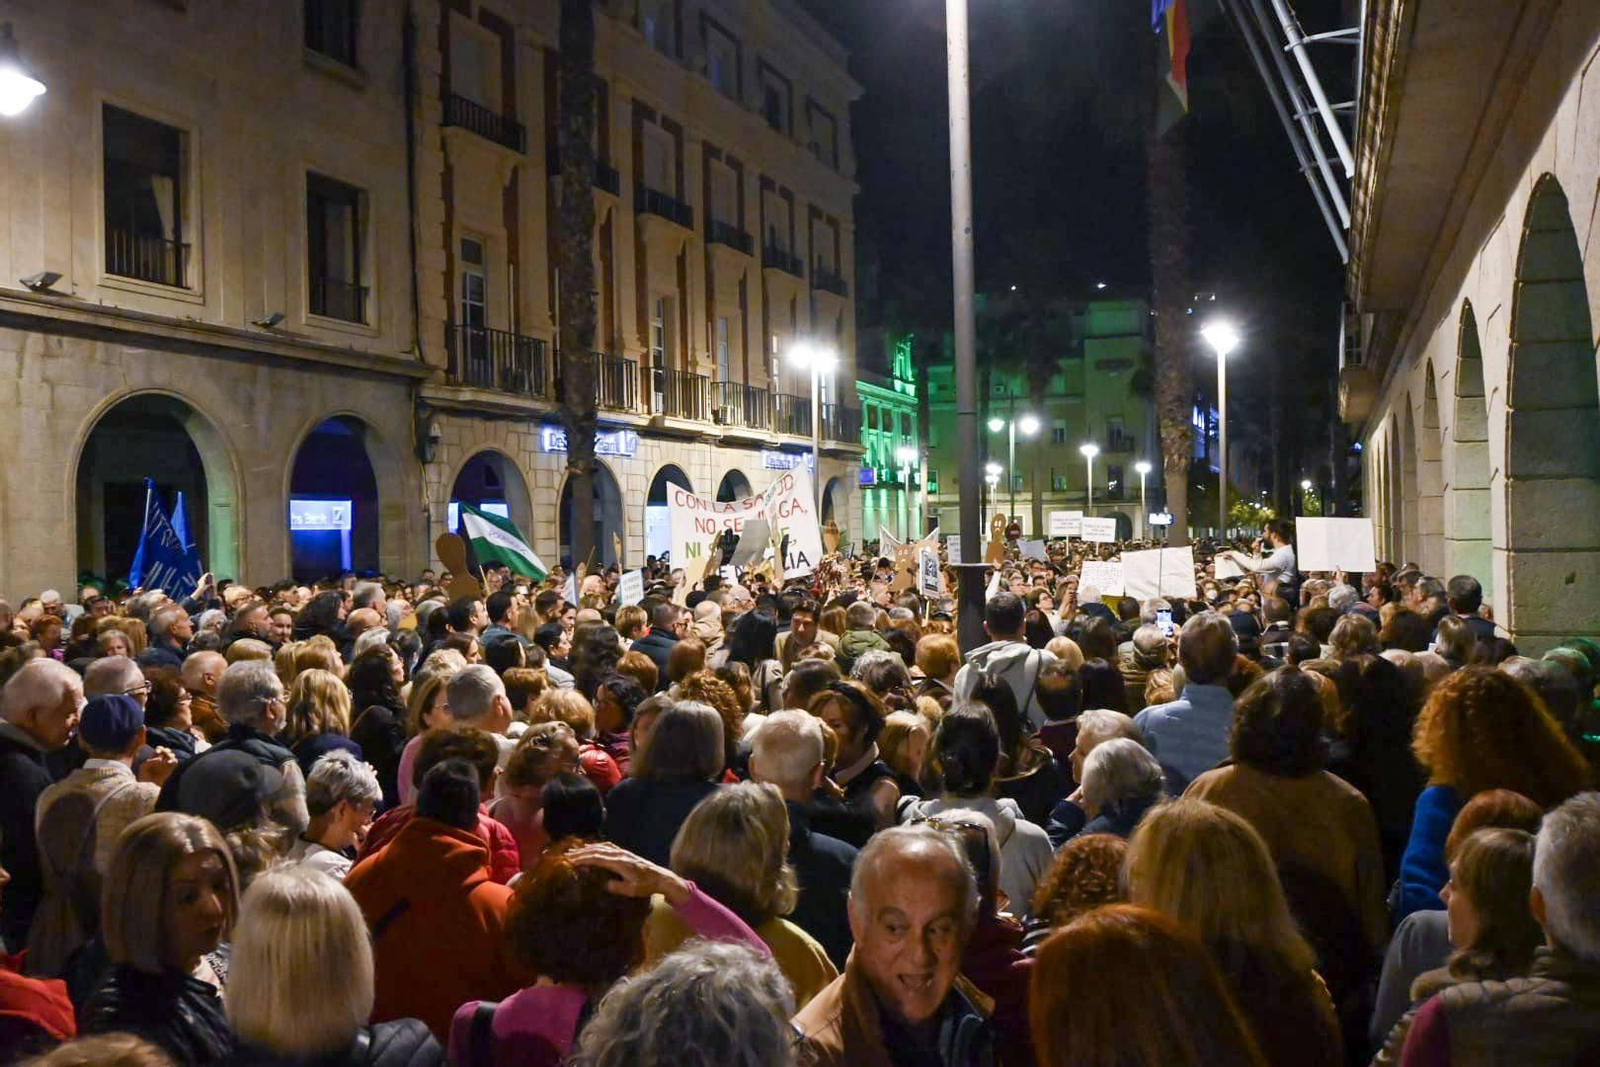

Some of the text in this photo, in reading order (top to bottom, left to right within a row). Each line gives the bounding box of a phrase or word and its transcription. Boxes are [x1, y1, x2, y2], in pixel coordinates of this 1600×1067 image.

[675, 490, 707, 511] CON
[712, 502, 736, 513] LA
[694, 516, 716, 534] NO
[723, 516, 744, 534] SE
[685, 541, 701, 559] NI
